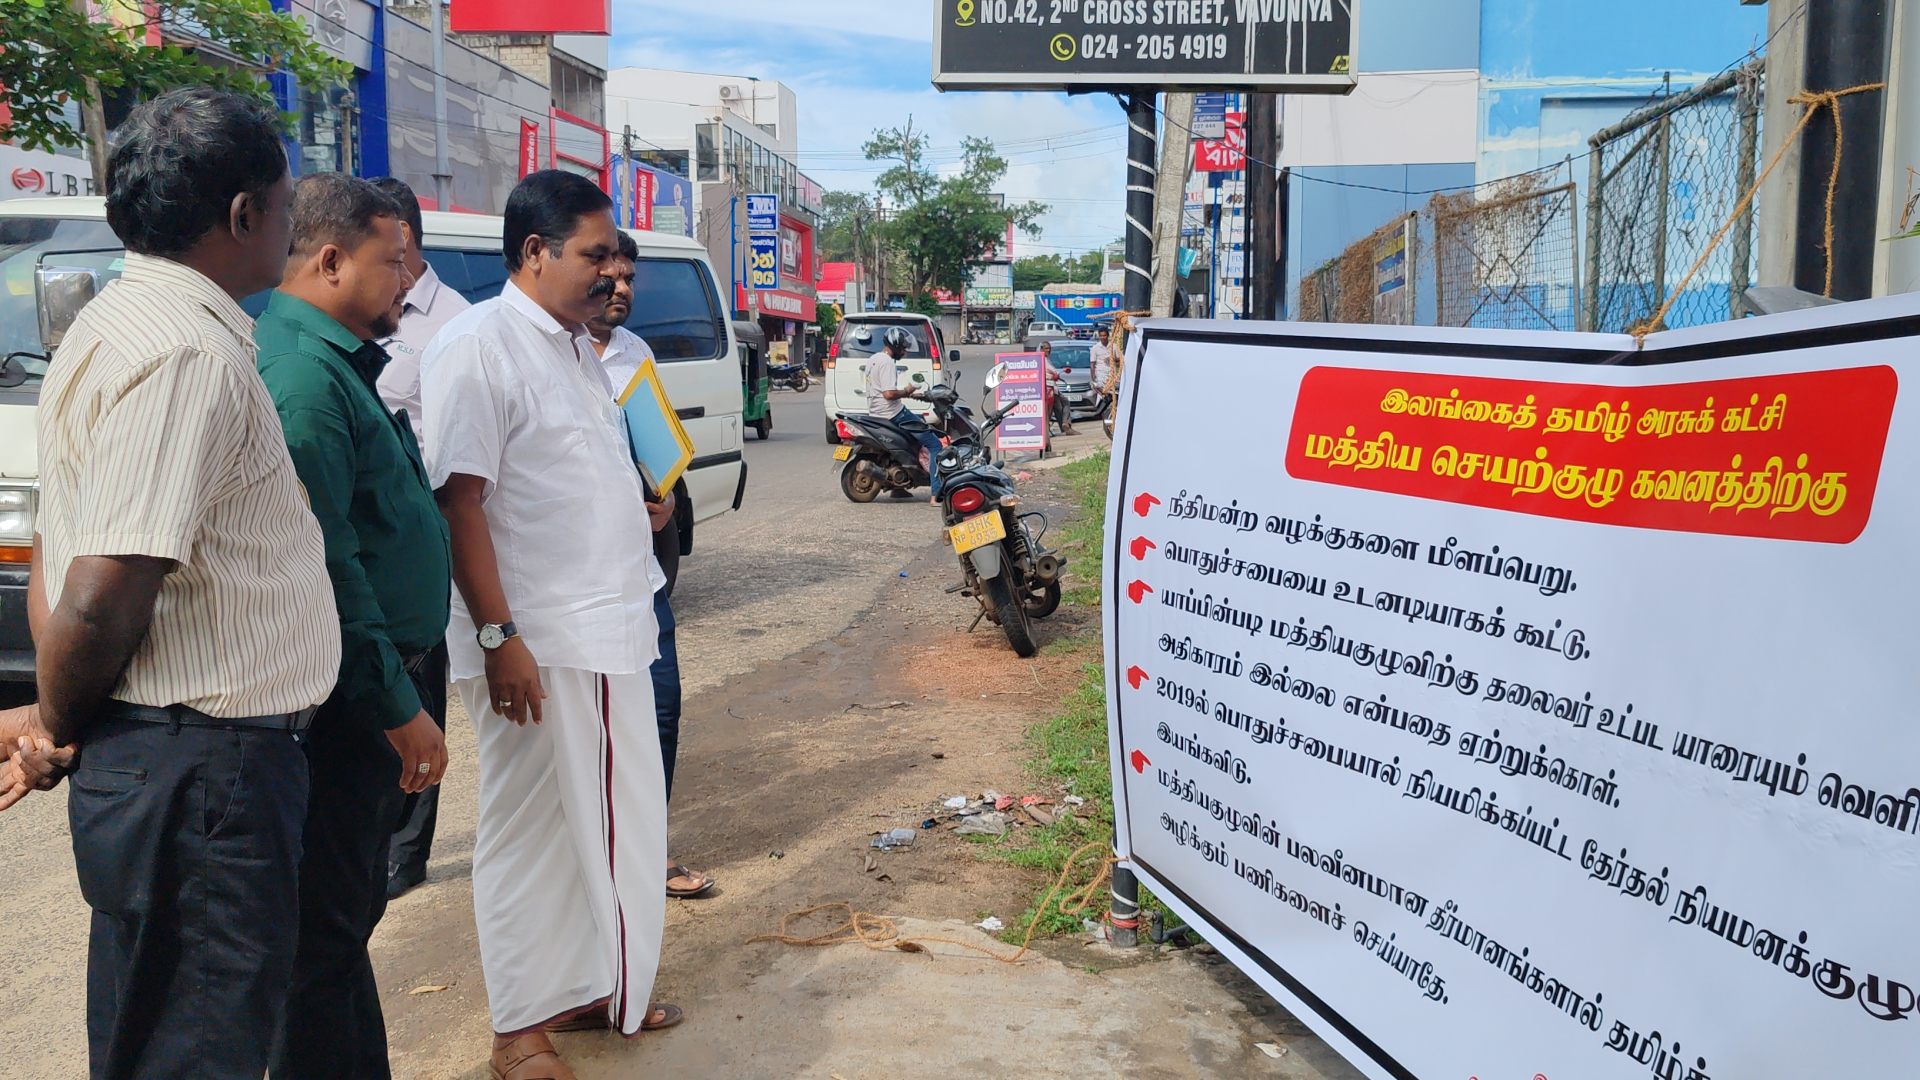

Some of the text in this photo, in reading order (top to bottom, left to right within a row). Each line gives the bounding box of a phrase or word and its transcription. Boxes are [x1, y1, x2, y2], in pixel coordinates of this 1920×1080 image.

[1081, 34, 1119, 59] 024
[1137, 34, 1174, 60] 205
[1179, 34, 1228, 60] 4919
[1083, 0, 1148, 25] CROSS
[1153, 0, 1229, 27] STREET,
[1235, 0, 1333, 25] VAVUNIYA
[1305, 425, 1847, 519] மத்திய செயற்குழு கவனத்திற்கு
[1381, 388, 1787, 443] இலங்கைத் தமிழ் அரசுக் கட்சி
[1167, 489, 1577, 597] நீதிமன்ற வழக்குகளை மீளப்பெறு.
[1165, 541, 1590, 661] பொதுச்சபையை உடனடியாகக் கூட்டு.
[1157, 722, 1252, 784] இயங்கவிடு.
[1158, 633, 1620, 809] அதிகாரம் இல்லை என்பதை ஏற்றுக்கொள்.
[1161, 587, 1920, 835] யாப்பின்படி மத்தியகுழுவிற்கு தலைவர் உட்பட யாரையும் வெளி
[1156, 676, 1920, 1021] 2019ல் பொதுச்சபையால் நியமிக்கப்பட்ட தேர்தல் நியமனக்குழு
[1158, 768, 1281, 849] மத்தியகுழுவின்
[1287, 837, 1429, 918] பலவீனமான
[1426, 899, 1603, 1032] தீர்மானங்களால்
[1160, 812, 1449, 1005] அழிக்கும் பணிகளைச் செய்யாதே.
